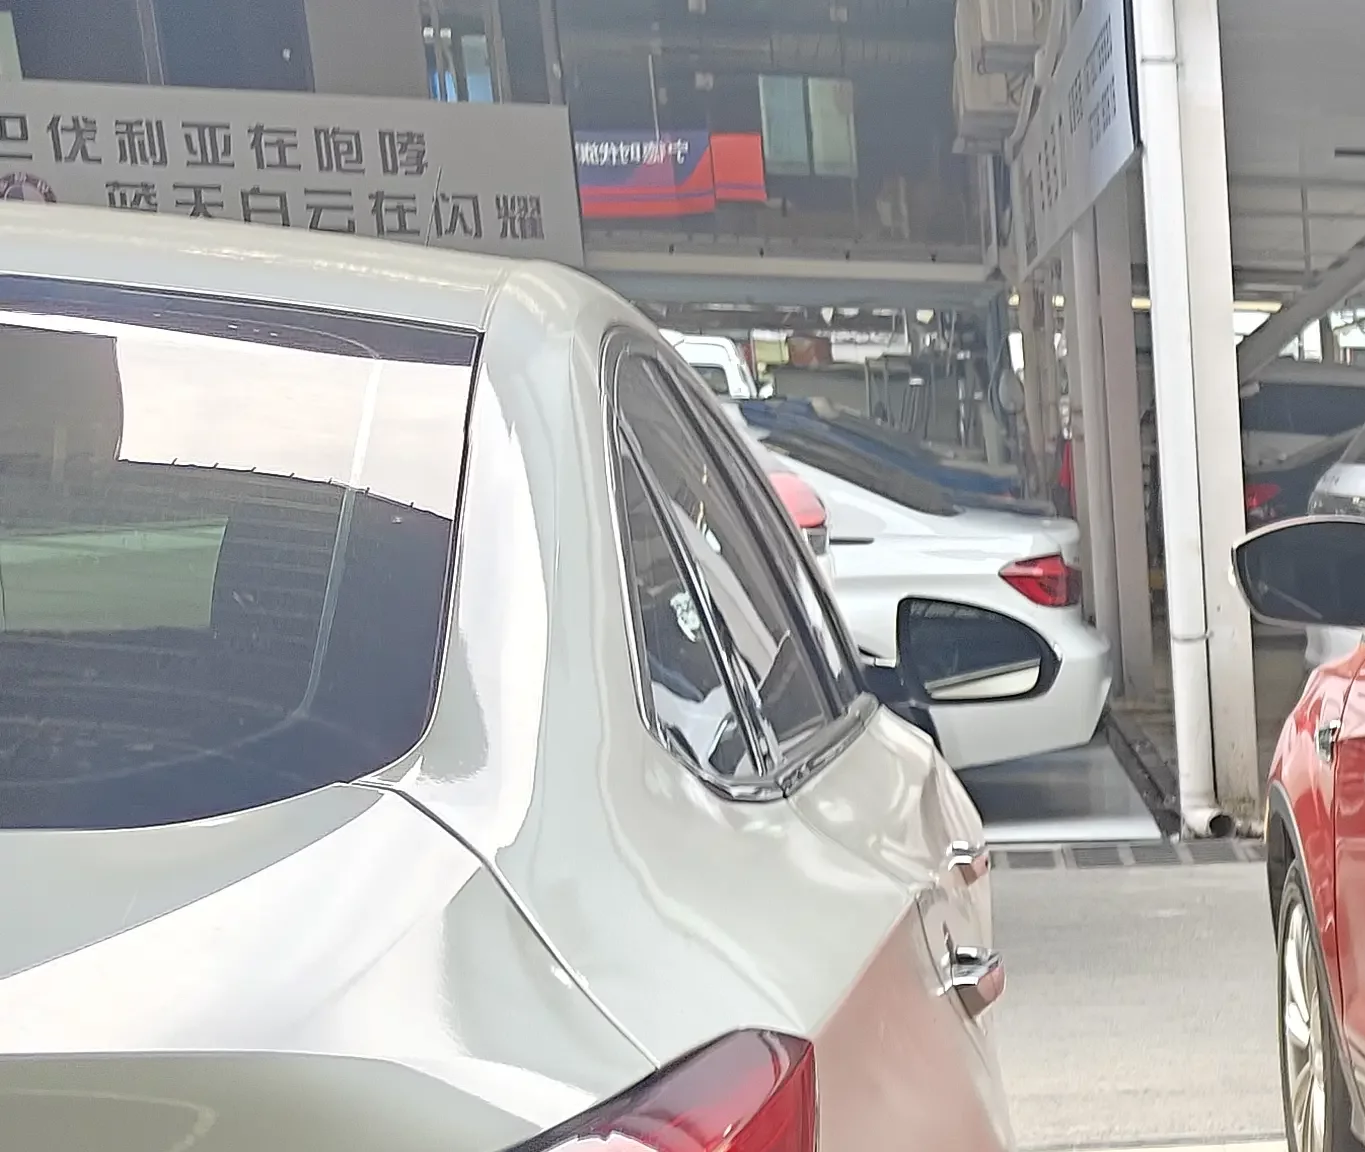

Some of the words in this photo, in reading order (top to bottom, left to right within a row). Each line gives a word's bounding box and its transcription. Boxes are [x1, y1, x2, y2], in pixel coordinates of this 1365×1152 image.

[105, 180, 545, 240] 蓝天白云在闪耀
